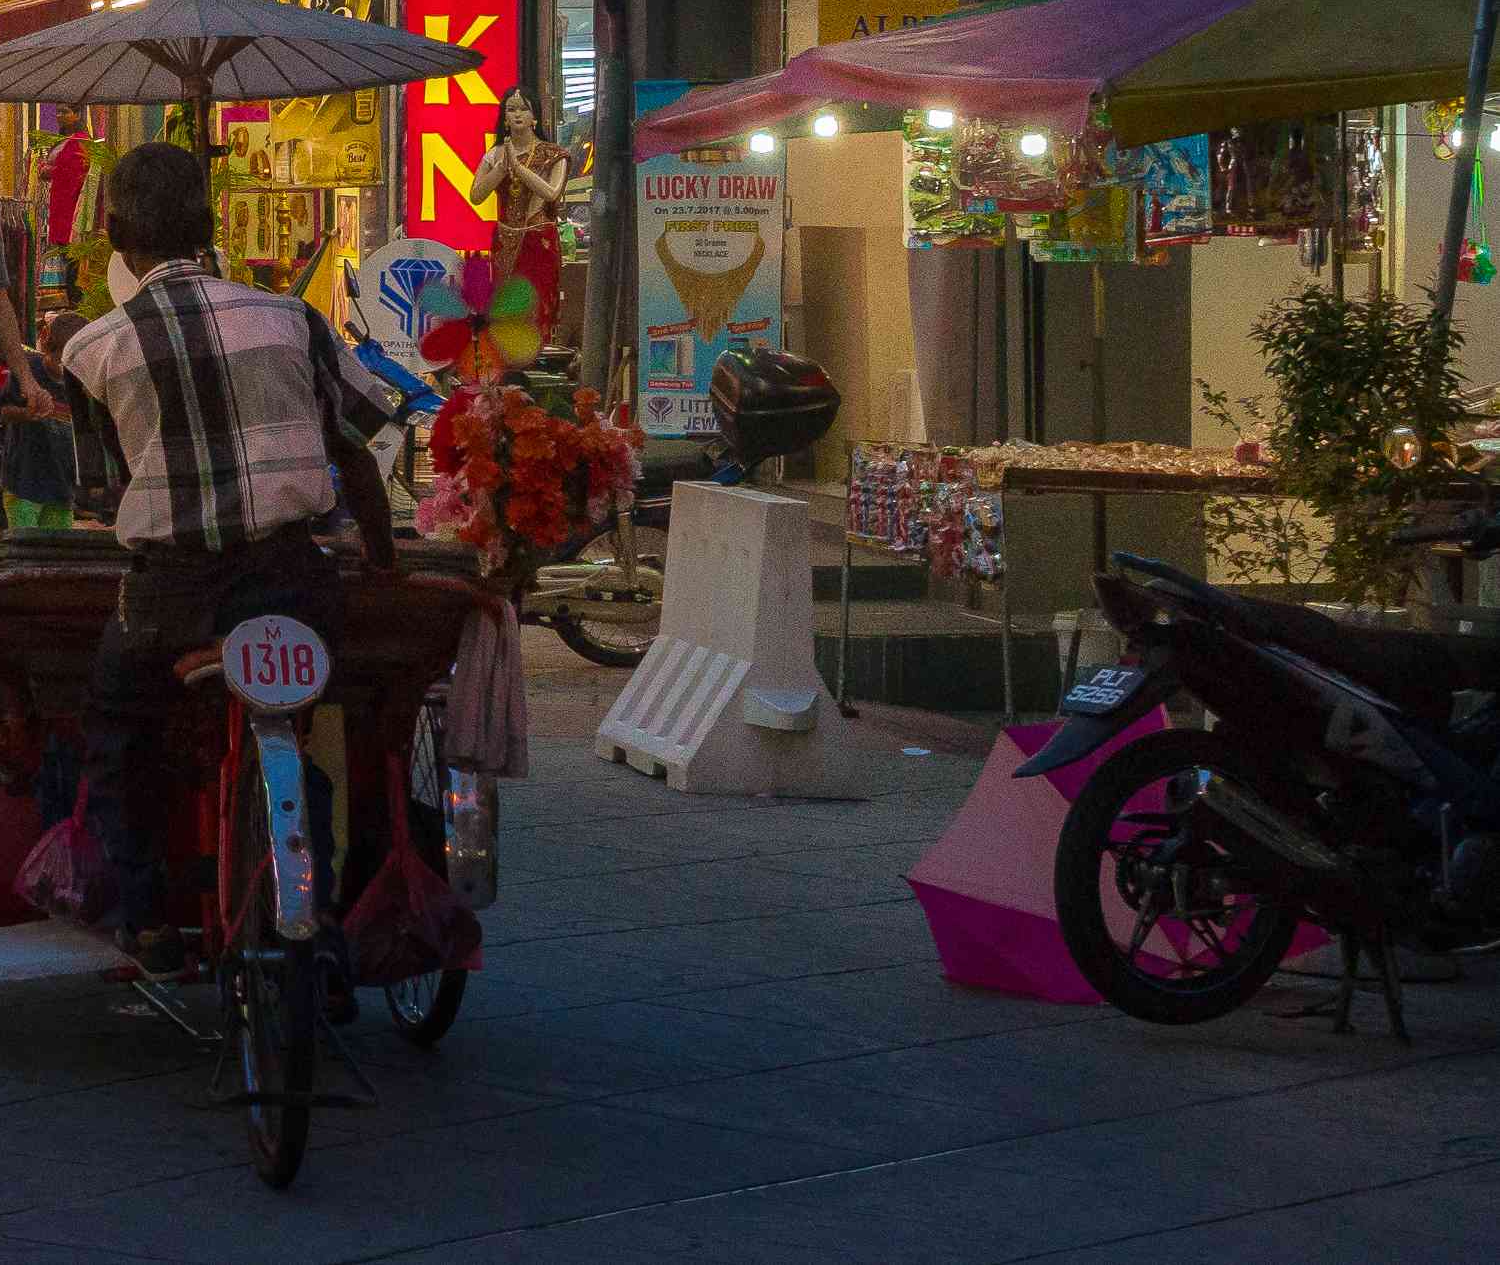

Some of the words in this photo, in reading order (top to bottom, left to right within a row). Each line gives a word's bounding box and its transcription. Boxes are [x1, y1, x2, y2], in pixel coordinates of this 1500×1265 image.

[643, 174, 711, 201] LUCKY
[718, 174, 778, 200] DRAW
[654, 206, 669, 215] On
[672, 206, 720, 215] 23.7.2017
[664, 220, 711, 233] FIRST
[712, 220, 760, 233] PRIZE
[264, 625, 282, 641] M
[241, 642, 315, 686] 1318
